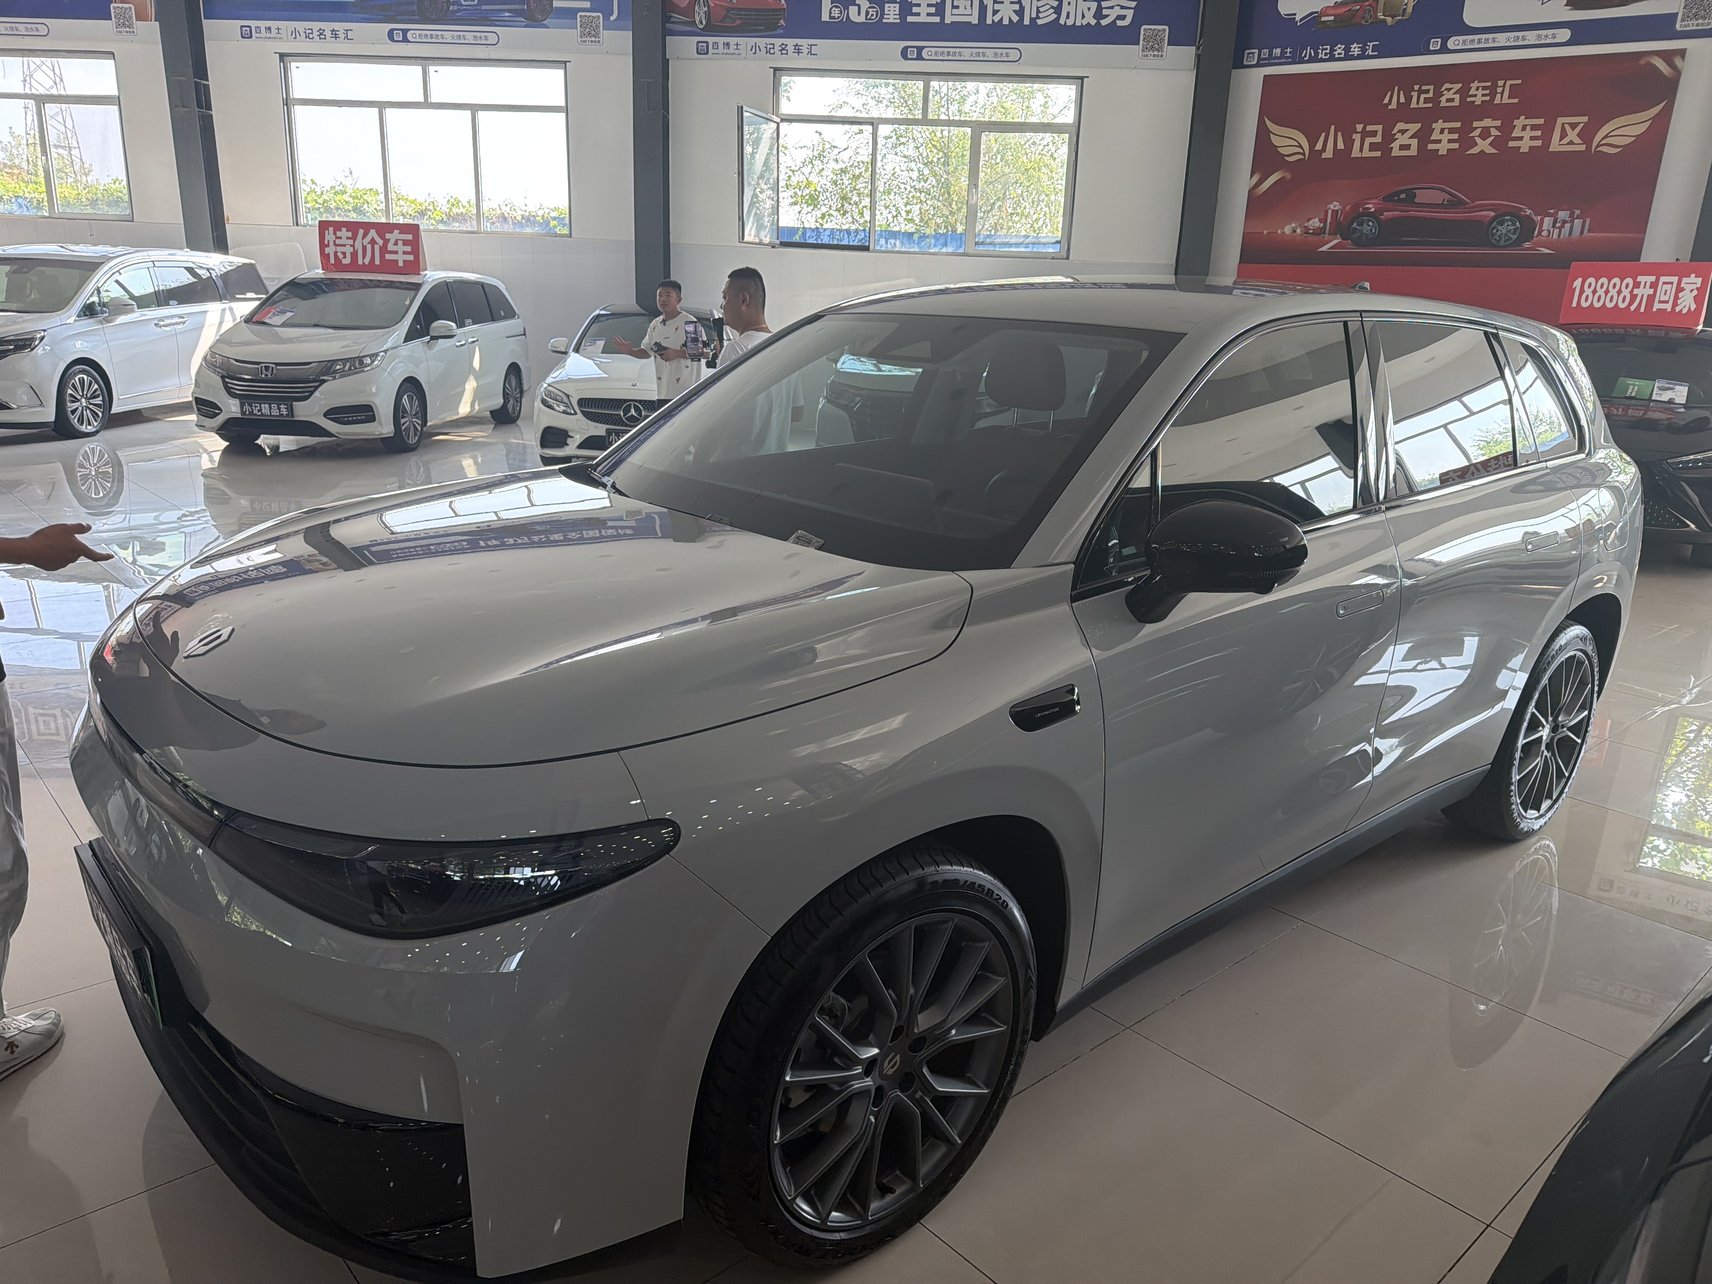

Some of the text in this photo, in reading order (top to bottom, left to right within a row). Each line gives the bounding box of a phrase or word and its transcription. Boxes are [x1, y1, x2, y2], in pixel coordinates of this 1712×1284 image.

[290, 27, 354, 40] 小记名车汇
[750, 42, 818, 56] 小记名车汇
[1301, 41, 1380, 60] 小记名车汇
[1382, 79, 1522, 110] 小记名车汇
[1313, 115, 1589, 160] 小记名车交车区
[324, 227, 415, 267] 特价车
[1571, 273, 1703, 314] 18888开回家
[241, 402, 289, 417] 小记精品车
